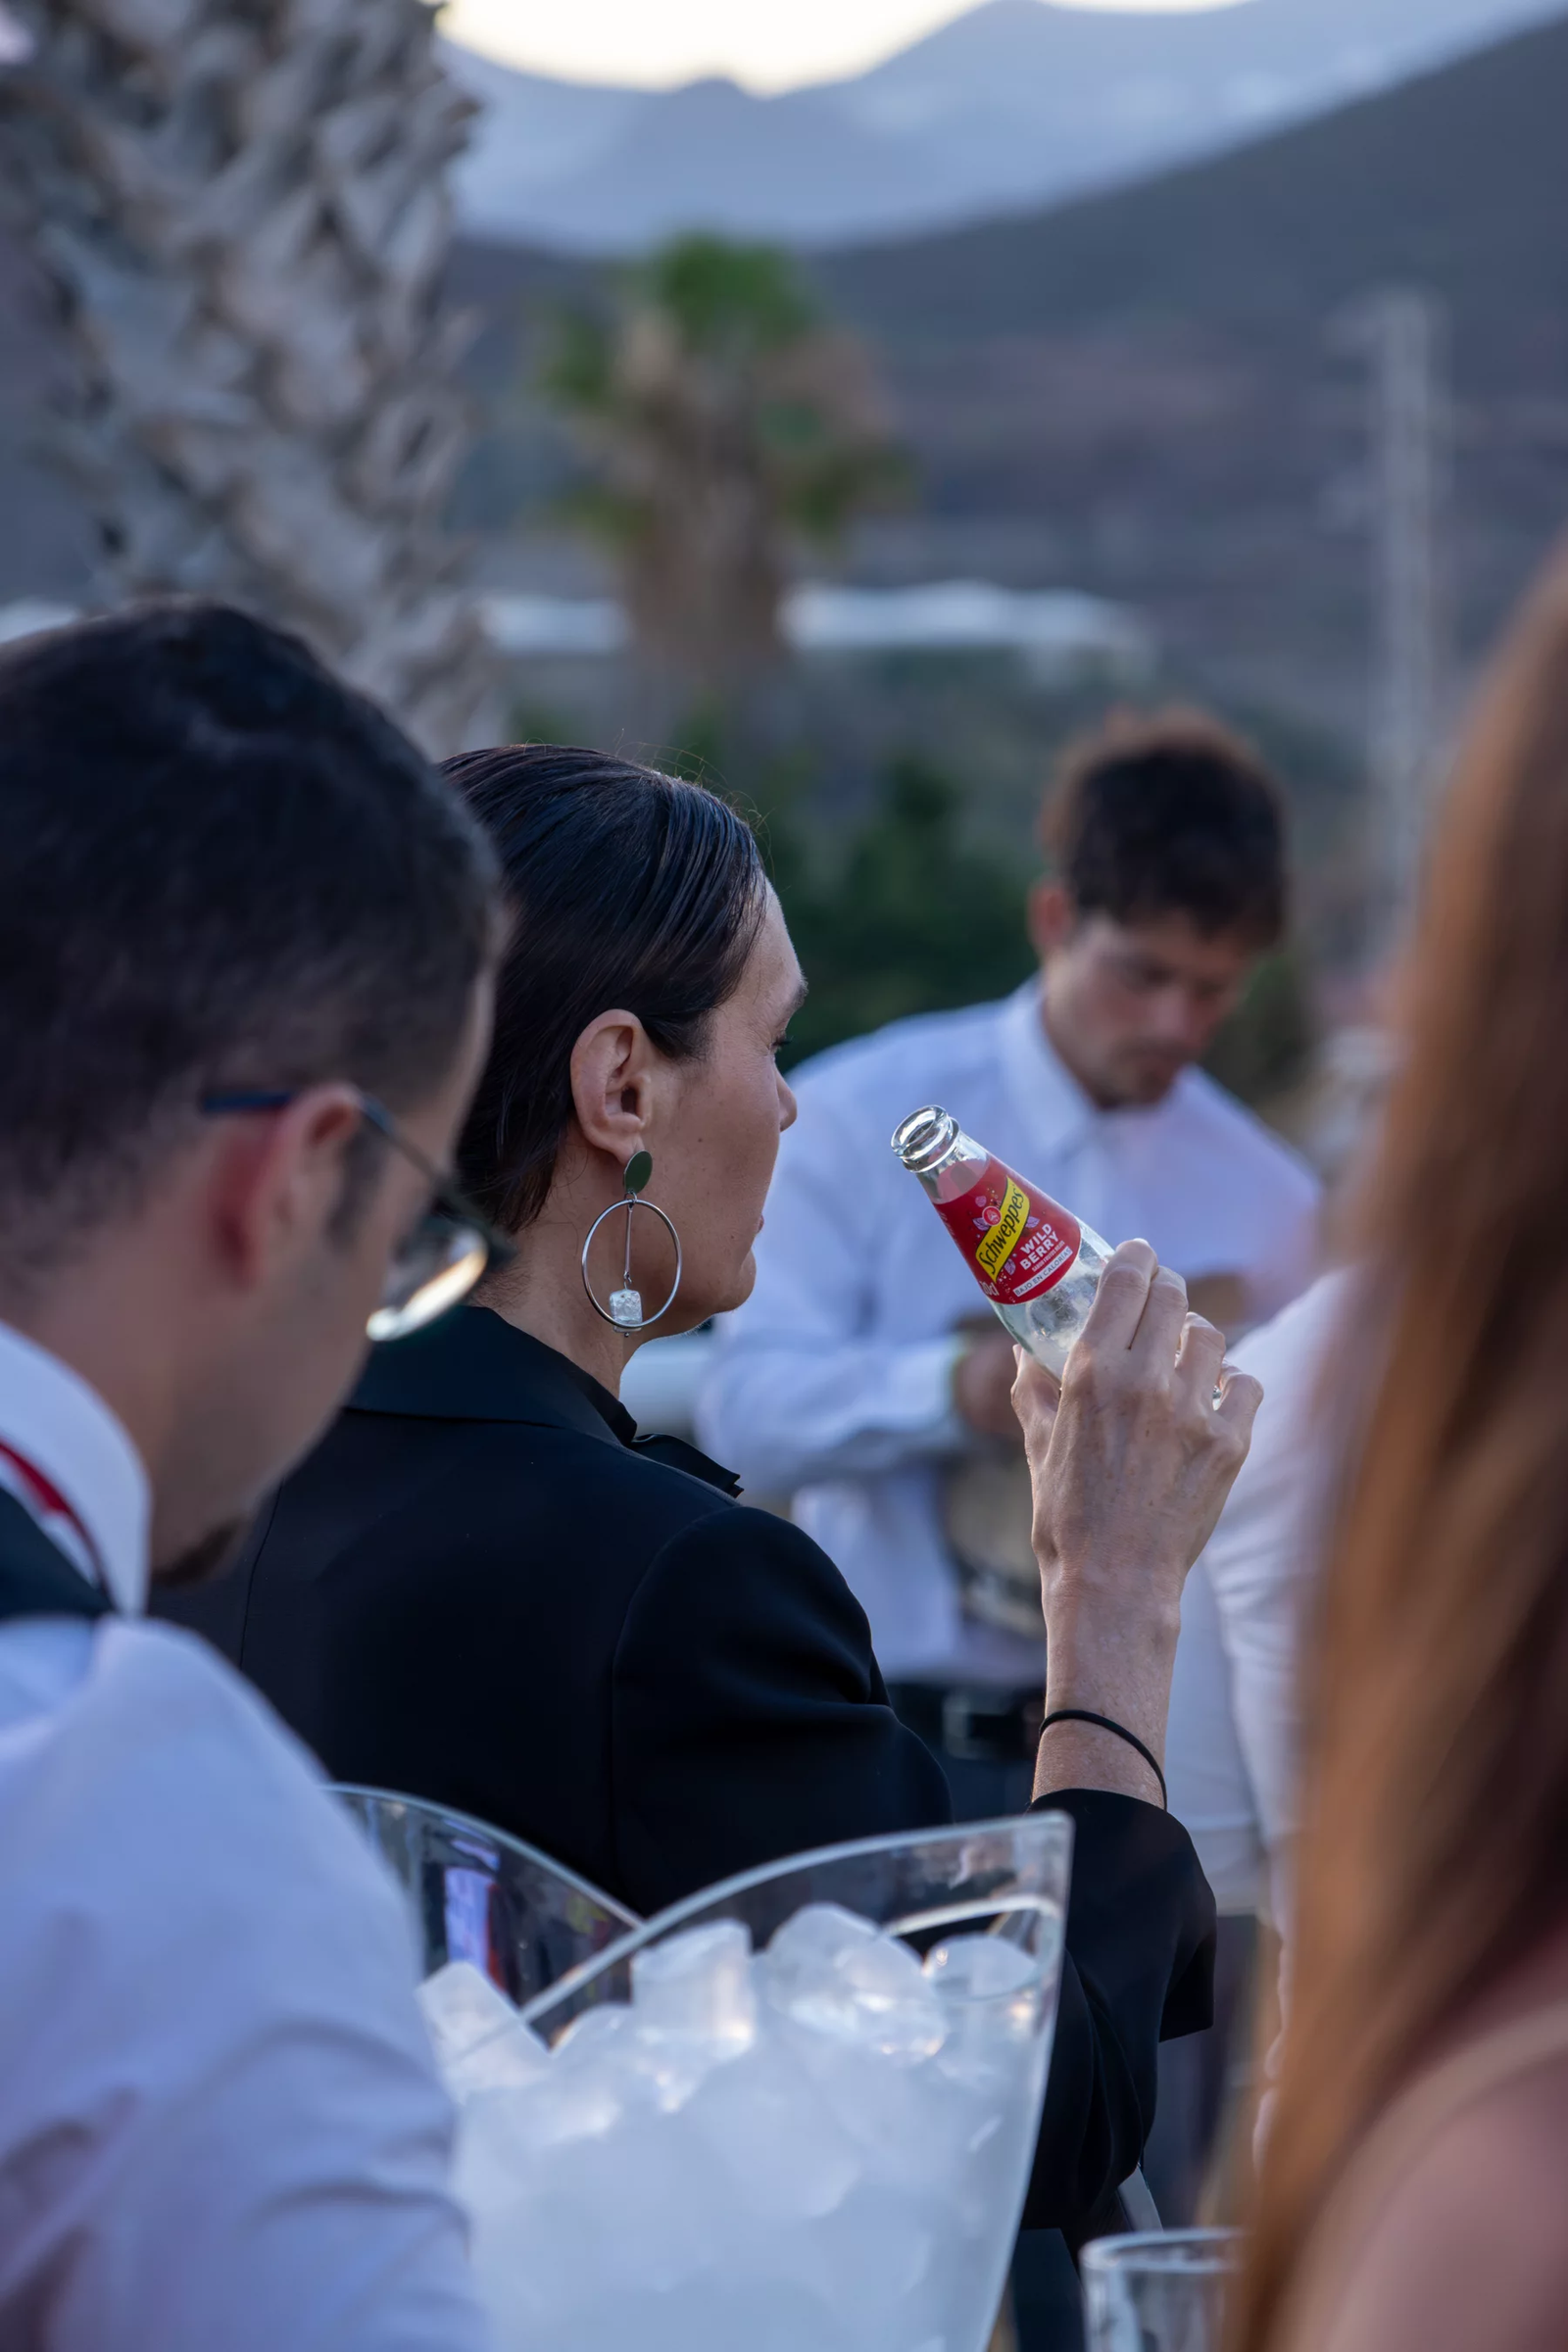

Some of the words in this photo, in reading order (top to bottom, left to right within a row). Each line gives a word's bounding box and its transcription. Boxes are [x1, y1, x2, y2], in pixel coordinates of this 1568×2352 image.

[979, 1188, 1025, 1275] Schweppes
[1020, 1223, 1052, 1254] WILD
[1020, 1231, 1058, 1270] BERRY
[1014, 1282, 1033, 1296] BAJO
[1032, 1274, 1044, 1284] EN
[1043, 1248, 1071, 1276] CALORÍAS
